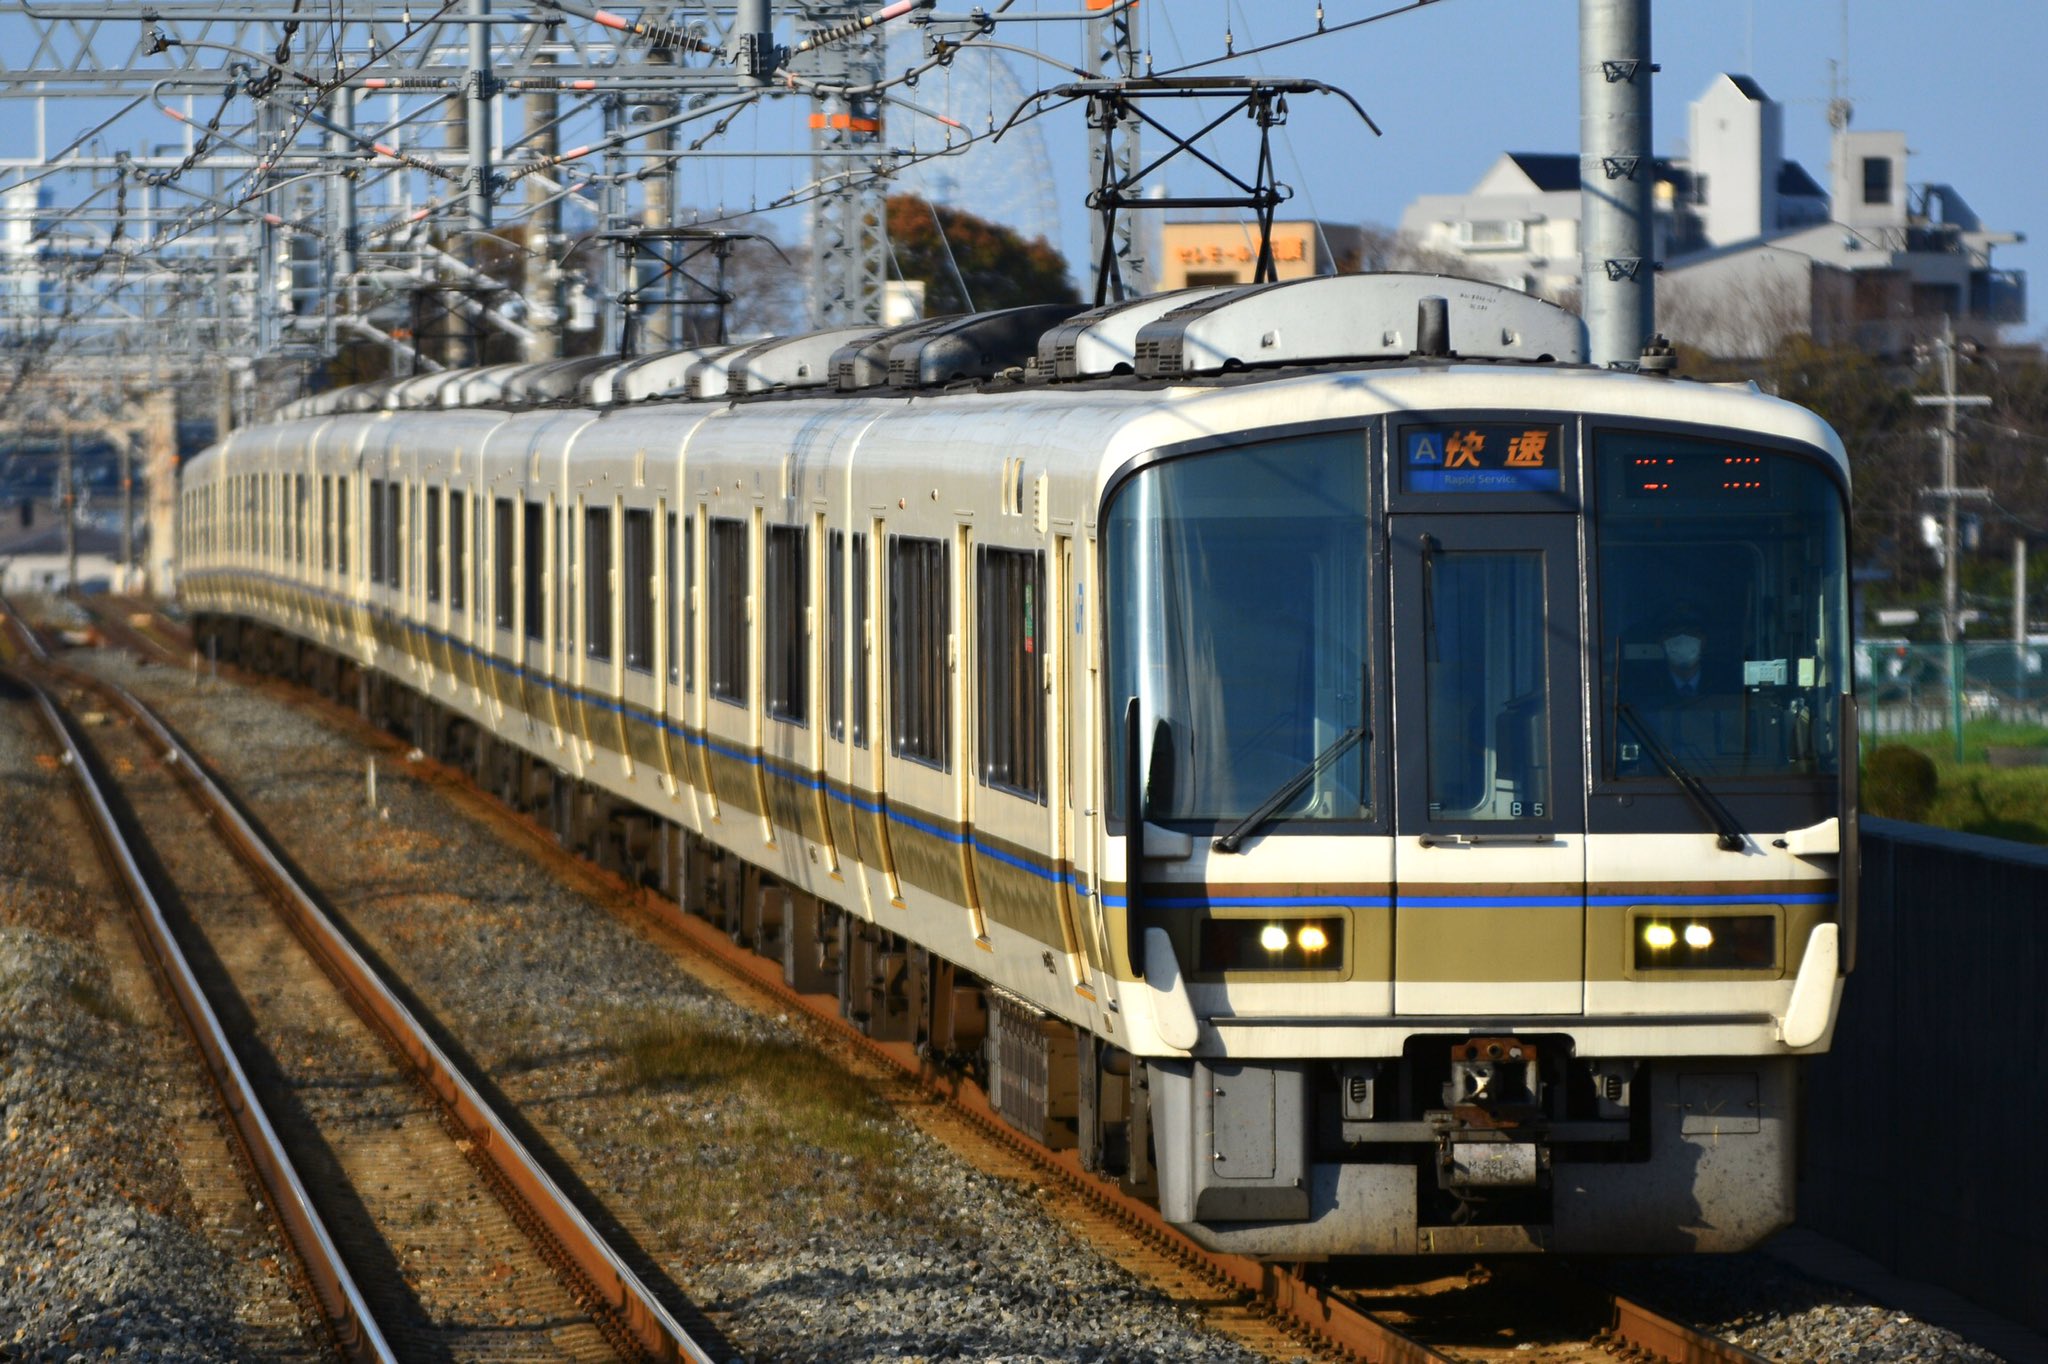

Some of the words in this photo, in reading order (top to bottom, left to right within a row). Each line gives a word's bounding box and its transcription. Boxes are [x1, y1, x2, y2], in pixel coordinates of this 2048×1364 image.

[1415, 437, 1436, 460] A
[1444, 474, 1476, 486] Rapid
[1478, 474, 1518, 484] Service
